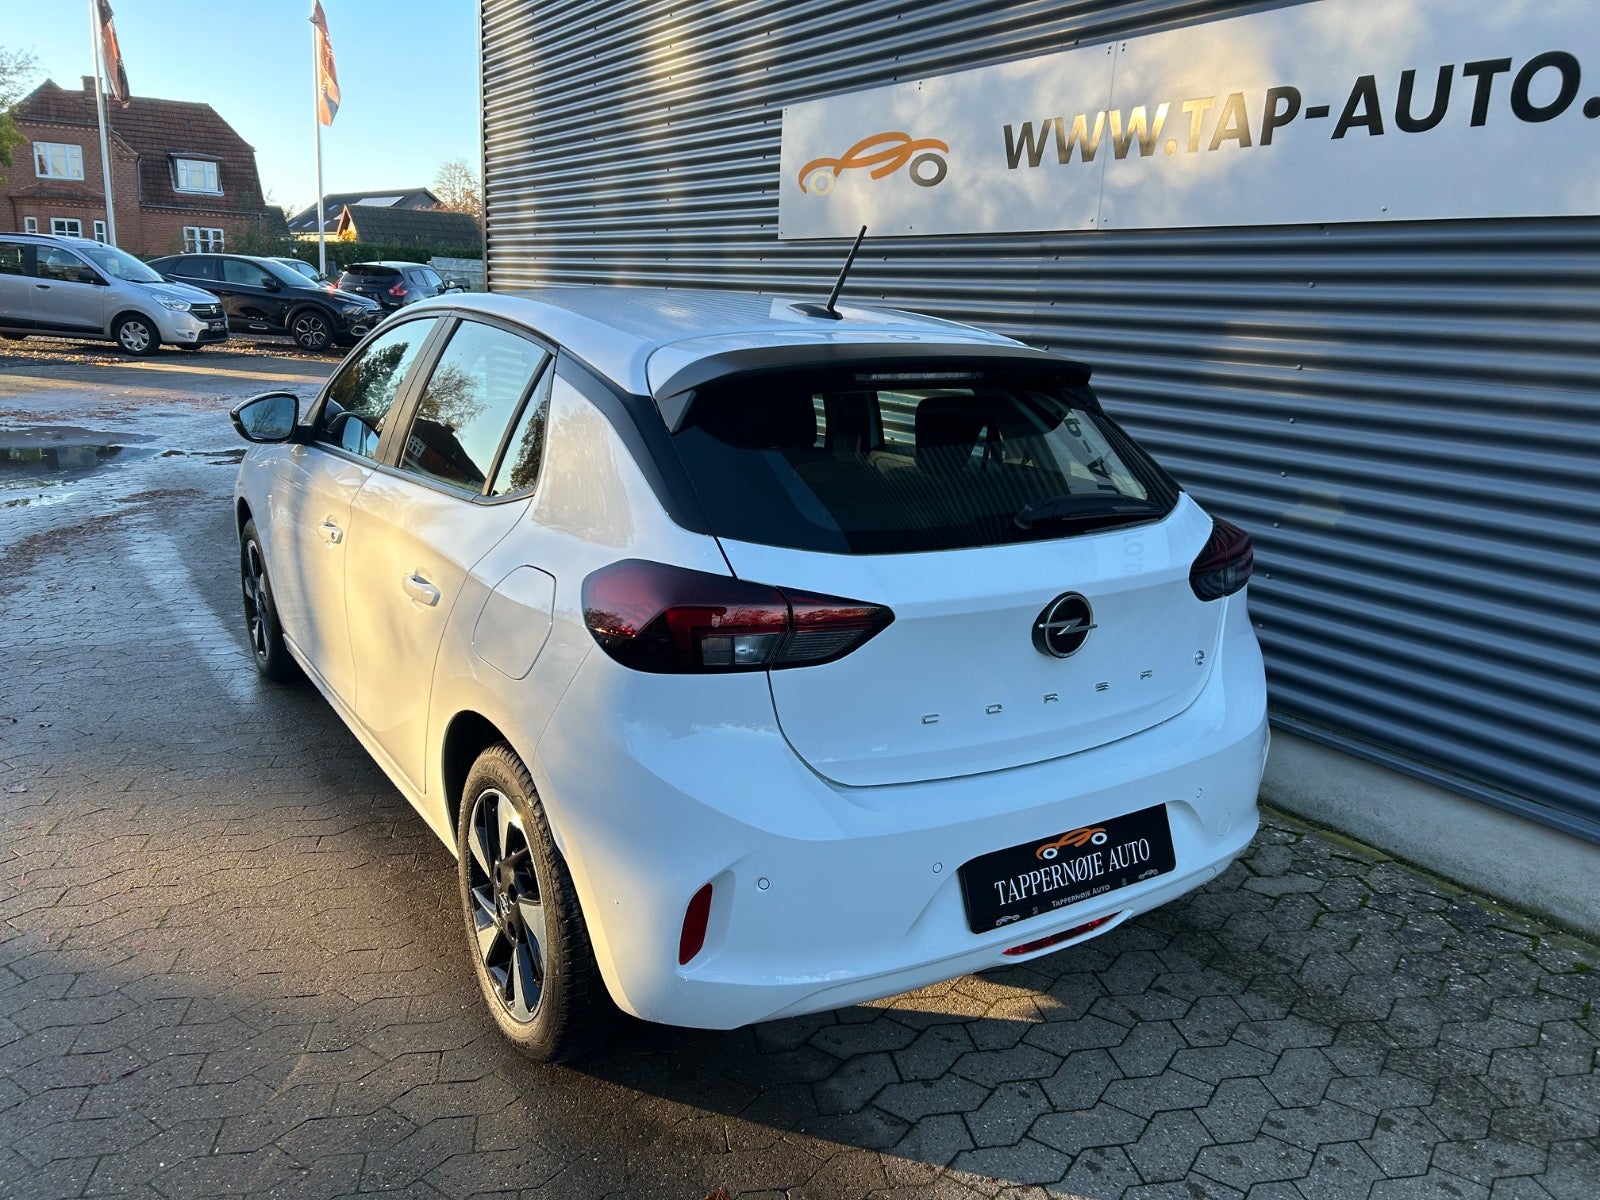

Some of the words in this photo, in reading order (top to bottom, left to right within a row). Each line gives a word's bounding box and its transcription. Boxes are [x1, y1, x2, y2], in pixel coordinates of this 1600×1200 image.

[1003, 50, 1600, 170] WWW.TAP-AUTO.
[921, 668, 1153, 725] CORSA
[994, 851, 1105, 906] TAPPERNØJE
[1108, 837, 1150, 873] AUTO
[1092, 884, 1111, 895] AUTO
